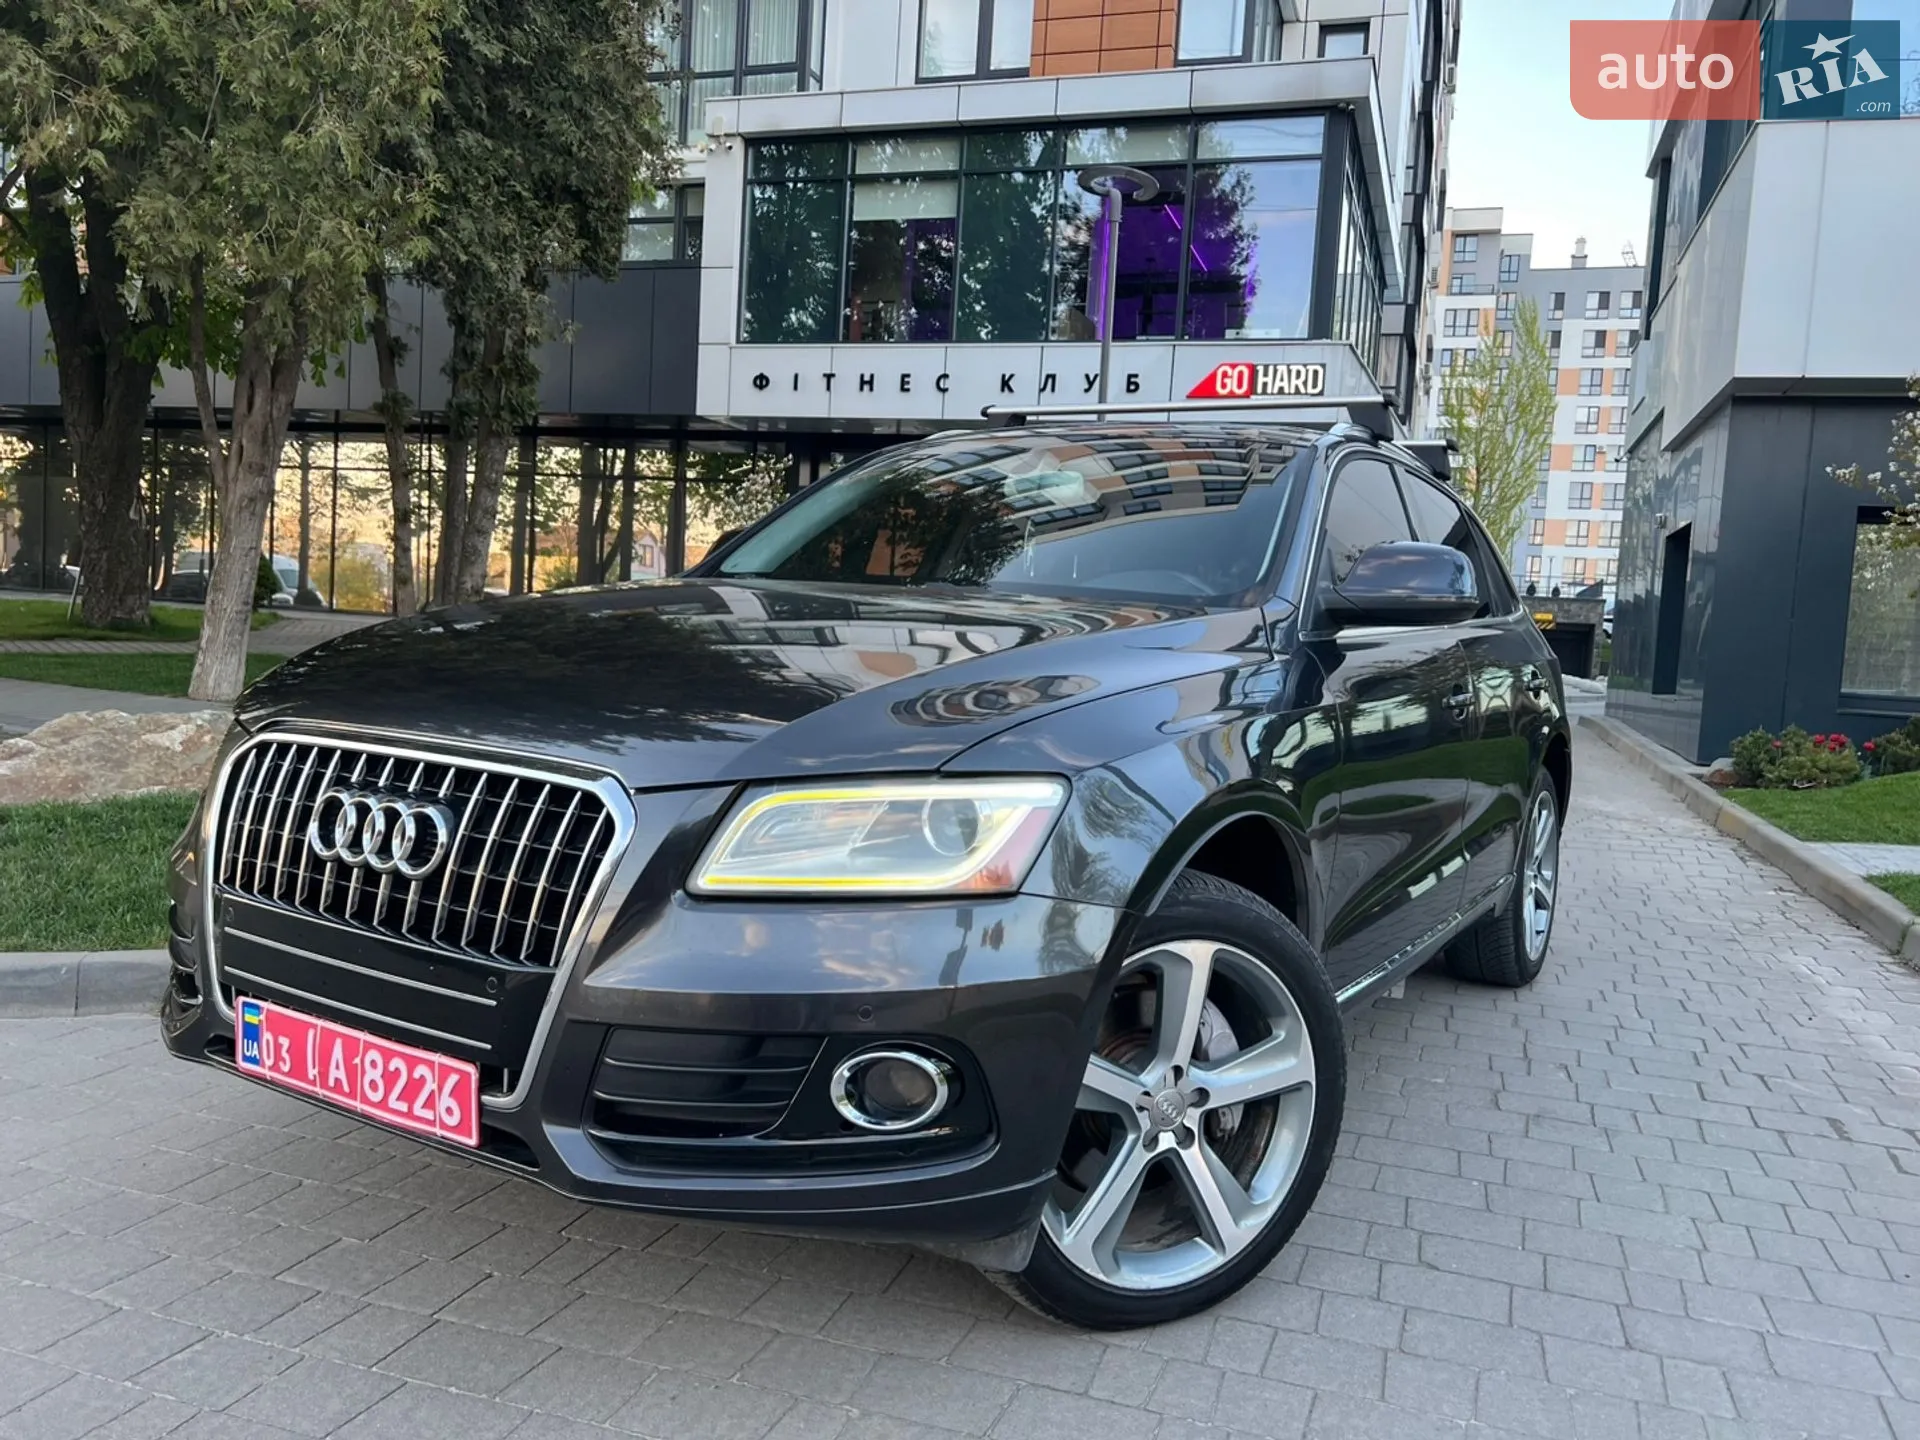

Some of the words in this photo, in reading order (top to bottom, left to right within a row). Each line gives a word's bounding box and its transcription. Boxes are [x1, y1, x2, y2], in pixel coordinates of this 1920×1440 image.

[753, 373, 949, 393] ФІТНЕС
[1000, 373, 1140, 393] КЛУБ
[1215, 364, 1249, 395] GO
[1256, 364, 1324, 394] HARD
[244, 1041, 259, 1059] UA
